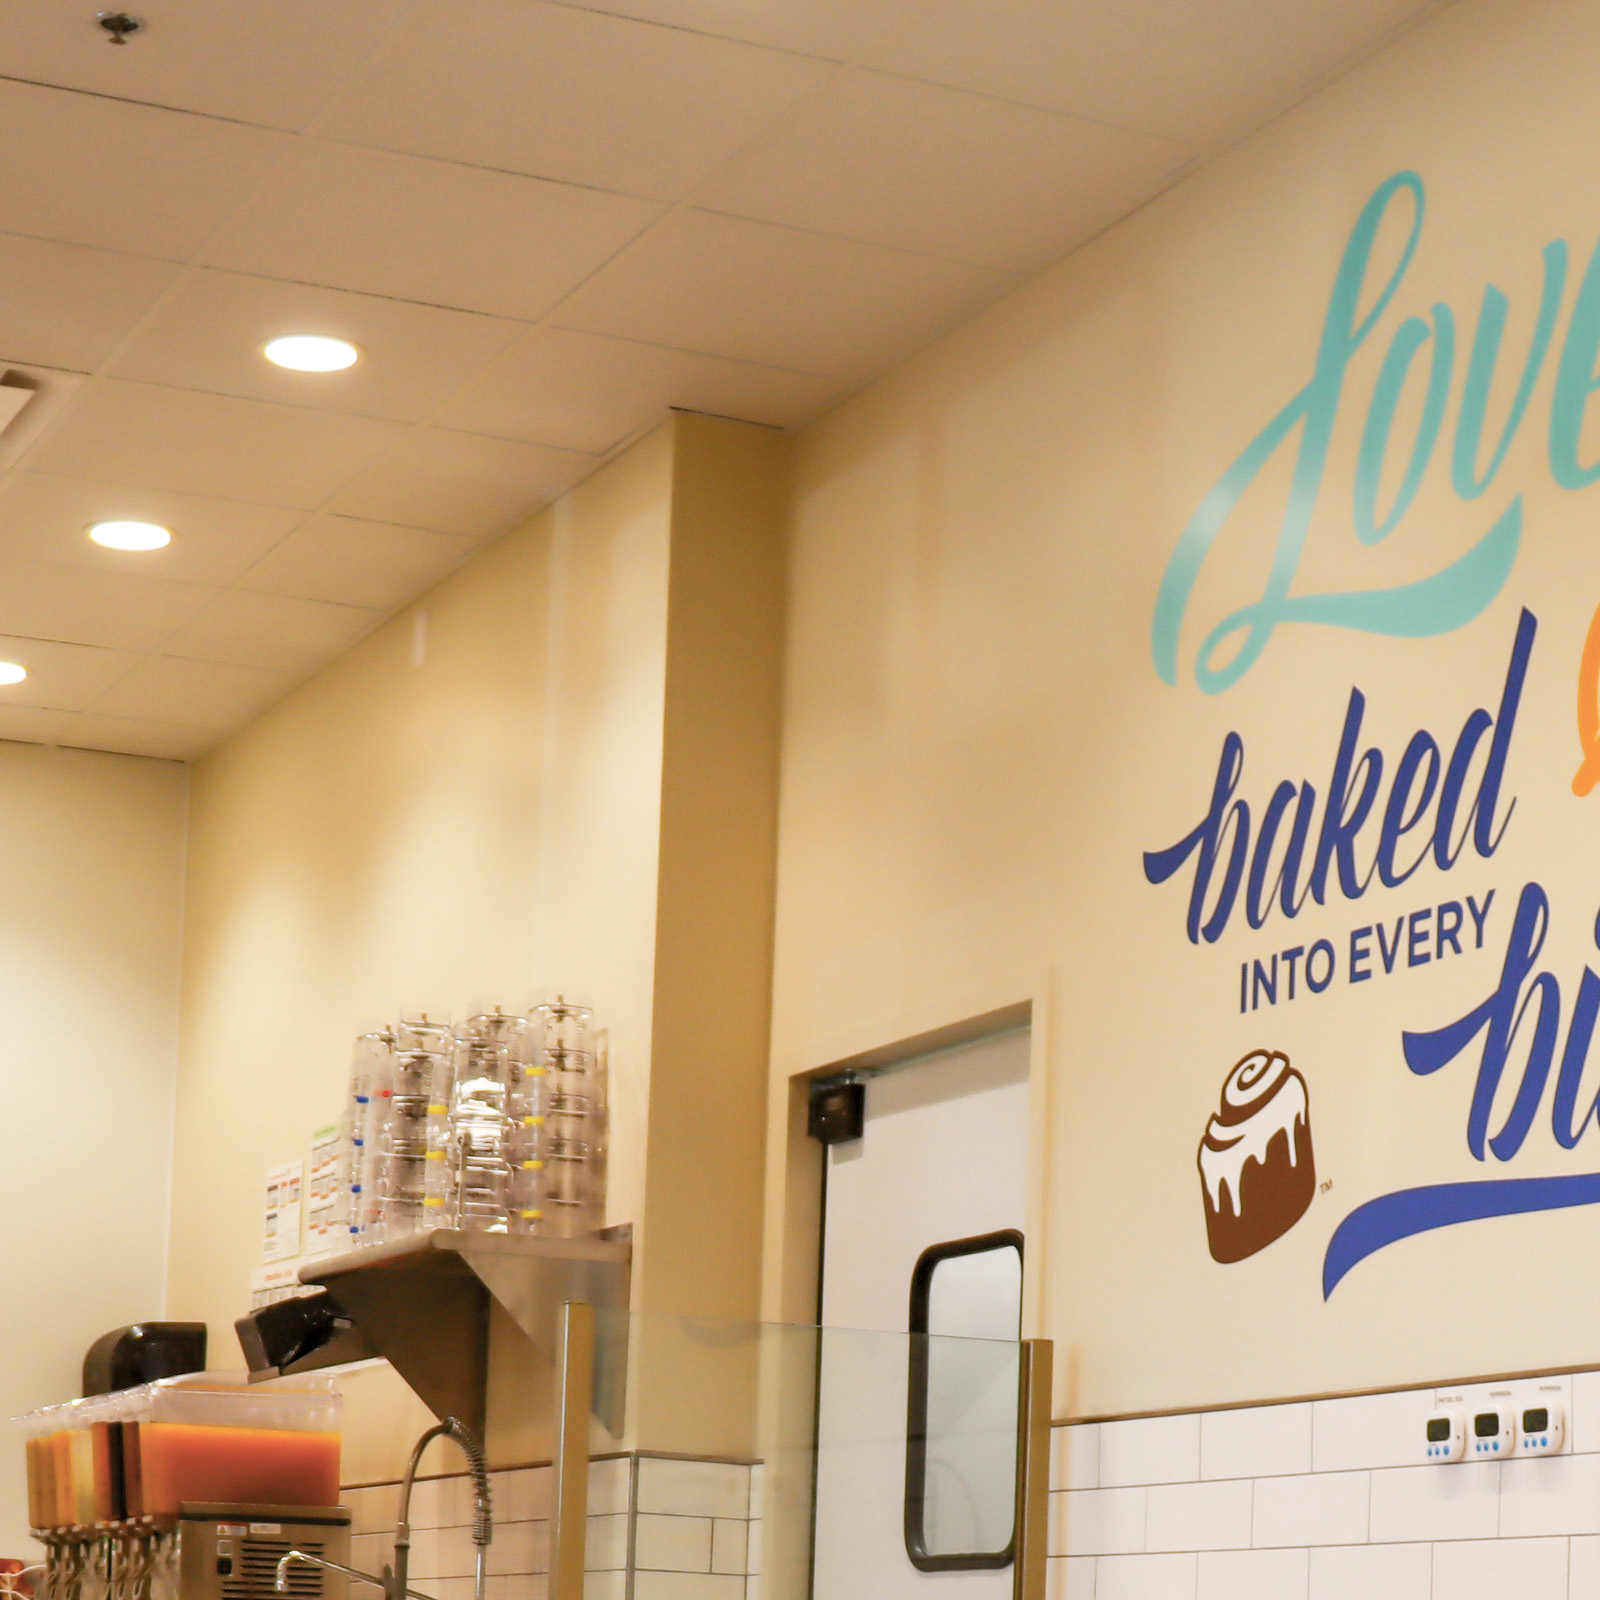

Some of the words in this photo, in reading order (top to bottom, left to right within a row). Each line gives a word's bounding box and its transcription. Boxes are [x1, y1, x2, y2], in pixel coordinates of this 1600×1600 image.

[1143, 606, 1537, 945] baked
[1239, 936, 1336, 1014] INTO
[1348, 888, 1496, 988] EVERY
[1320, 1179, 1333, 1194] TM
